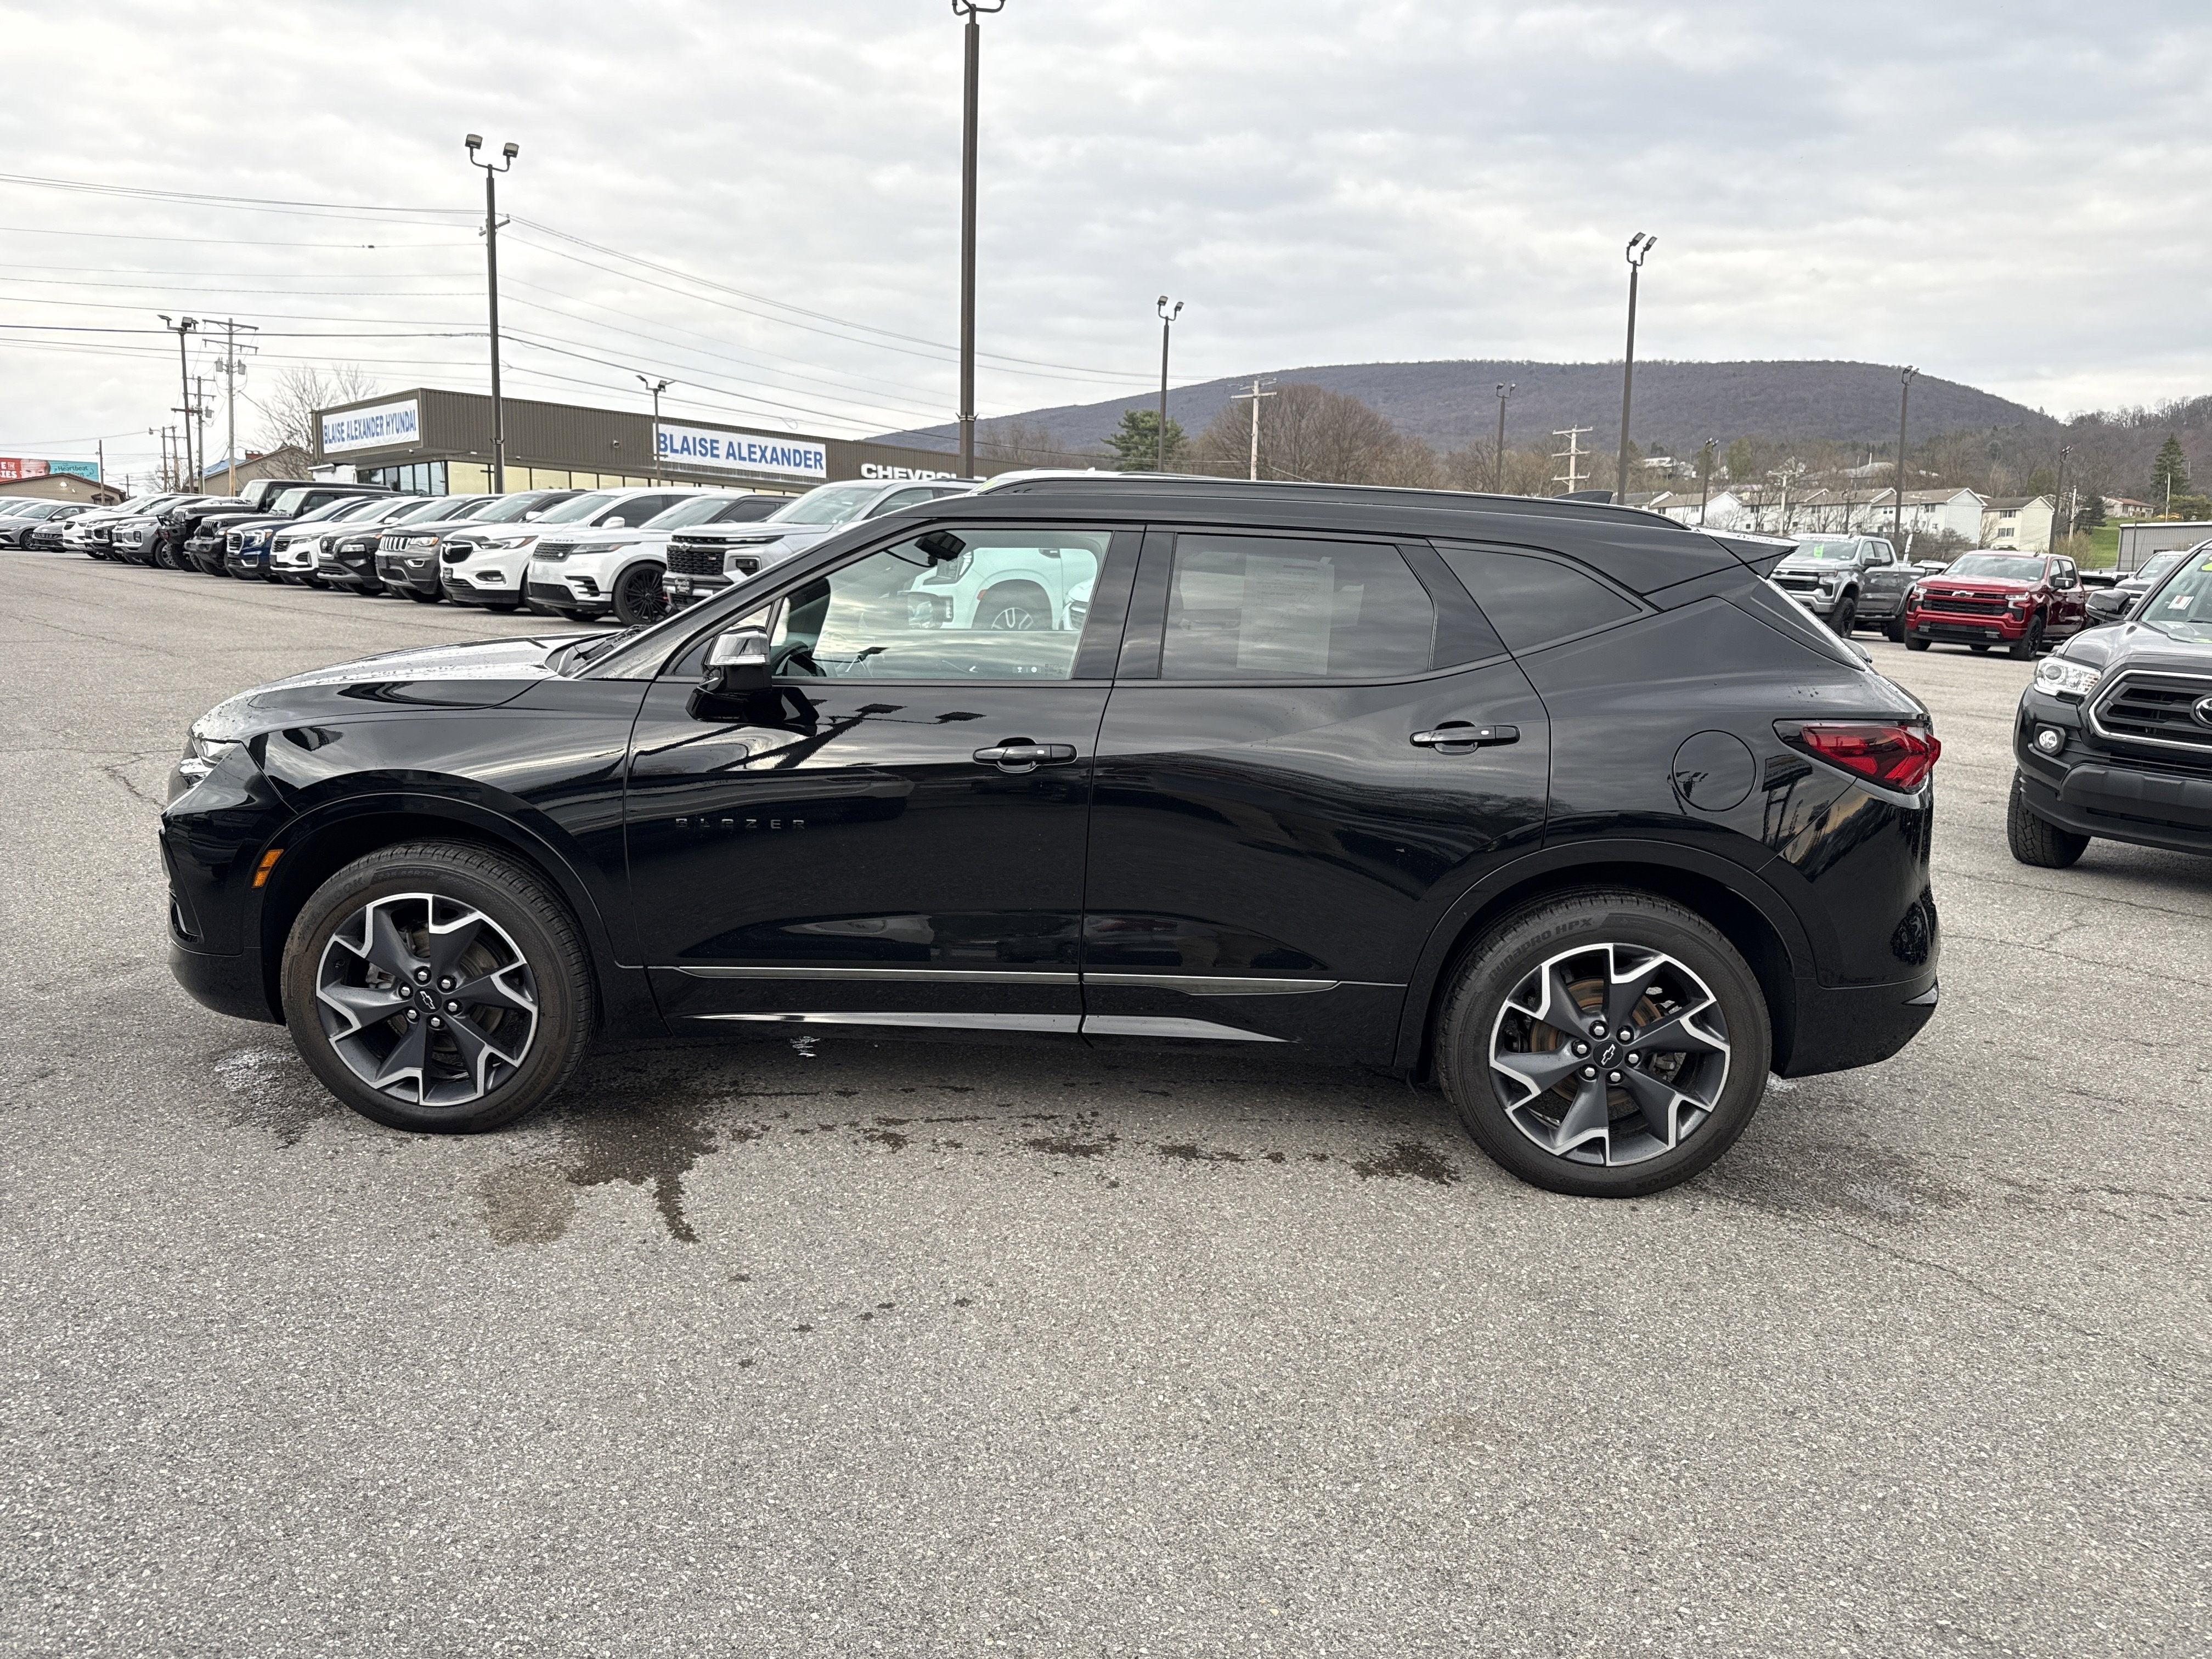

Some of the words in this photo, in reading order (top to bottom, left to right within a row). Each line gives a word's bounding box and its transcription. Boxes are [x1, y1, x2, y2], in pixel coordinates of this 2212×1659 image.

[324, 422, 345, 444] BLAISE
[347, 415, 383, 441] ALEXANDER
[386, 409, 416, 435] HYUNDAI
[658, 433, 720, 459] BLAISE
[725, 441, 823, 470] ALEXANDER
[0, 470, 17, 479] IES
[861, 464, 987, 481] CHEVR
[675, 818, 805, 830] BLAZER
[1555, 917, 1593, 935] HPX
